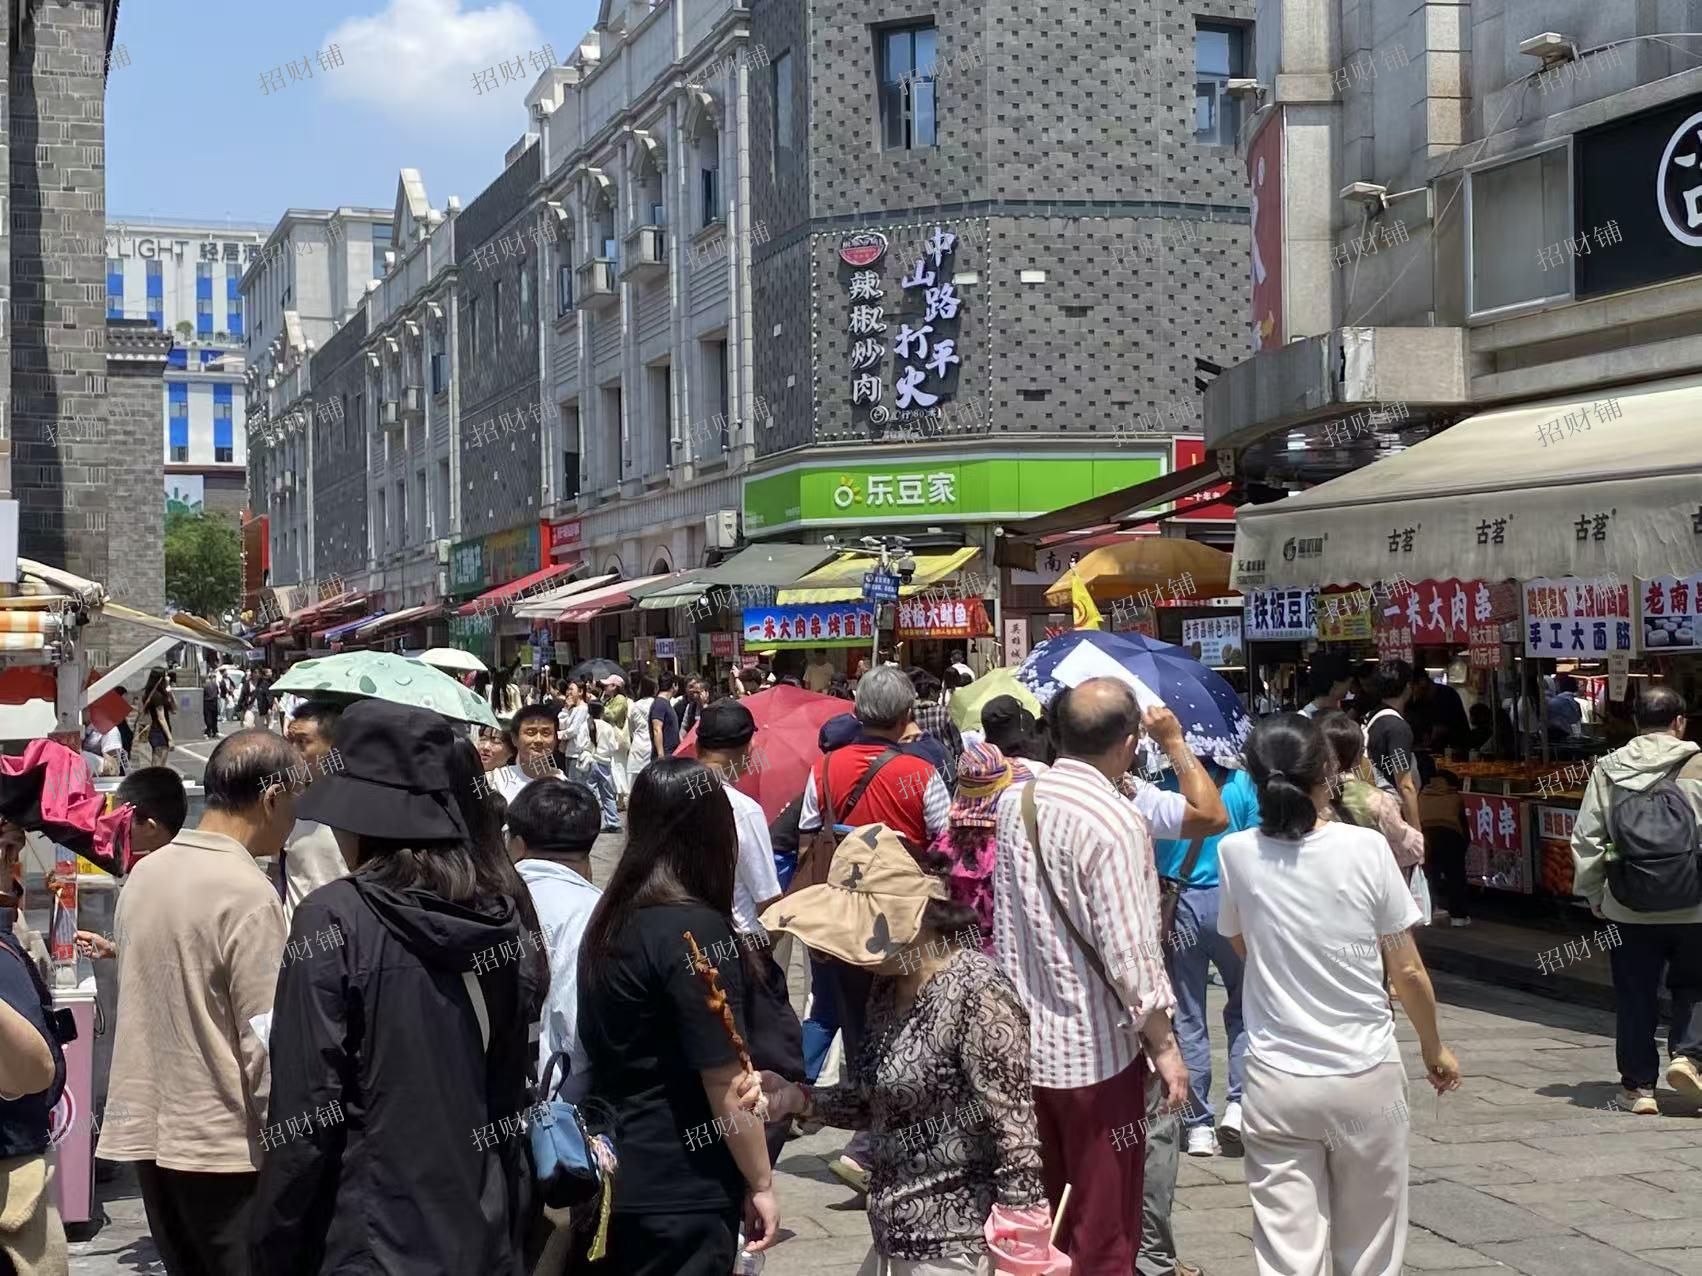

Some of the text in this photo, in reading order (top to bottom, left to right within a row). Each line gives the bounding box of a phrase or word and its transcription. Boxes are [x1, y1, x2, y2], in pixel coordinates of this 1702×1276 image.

[850, 271, 886, 405] 辣椒炒肉
[866, 472, 956, 506] 乐豆家
[1387, 528, 1416, 552] 古茗
[1476, 518, 1507, 544] 古茗
[1574, 514, 1609, 541] 古茗
[1254, 590, 1318, 629] 铁板豆腐
[1383, 582, 1492, 636] 一米大肉串
[1529, 621, 1631, 650] 手工大面筋
[1468, 797, 1516, 848] 肉串
